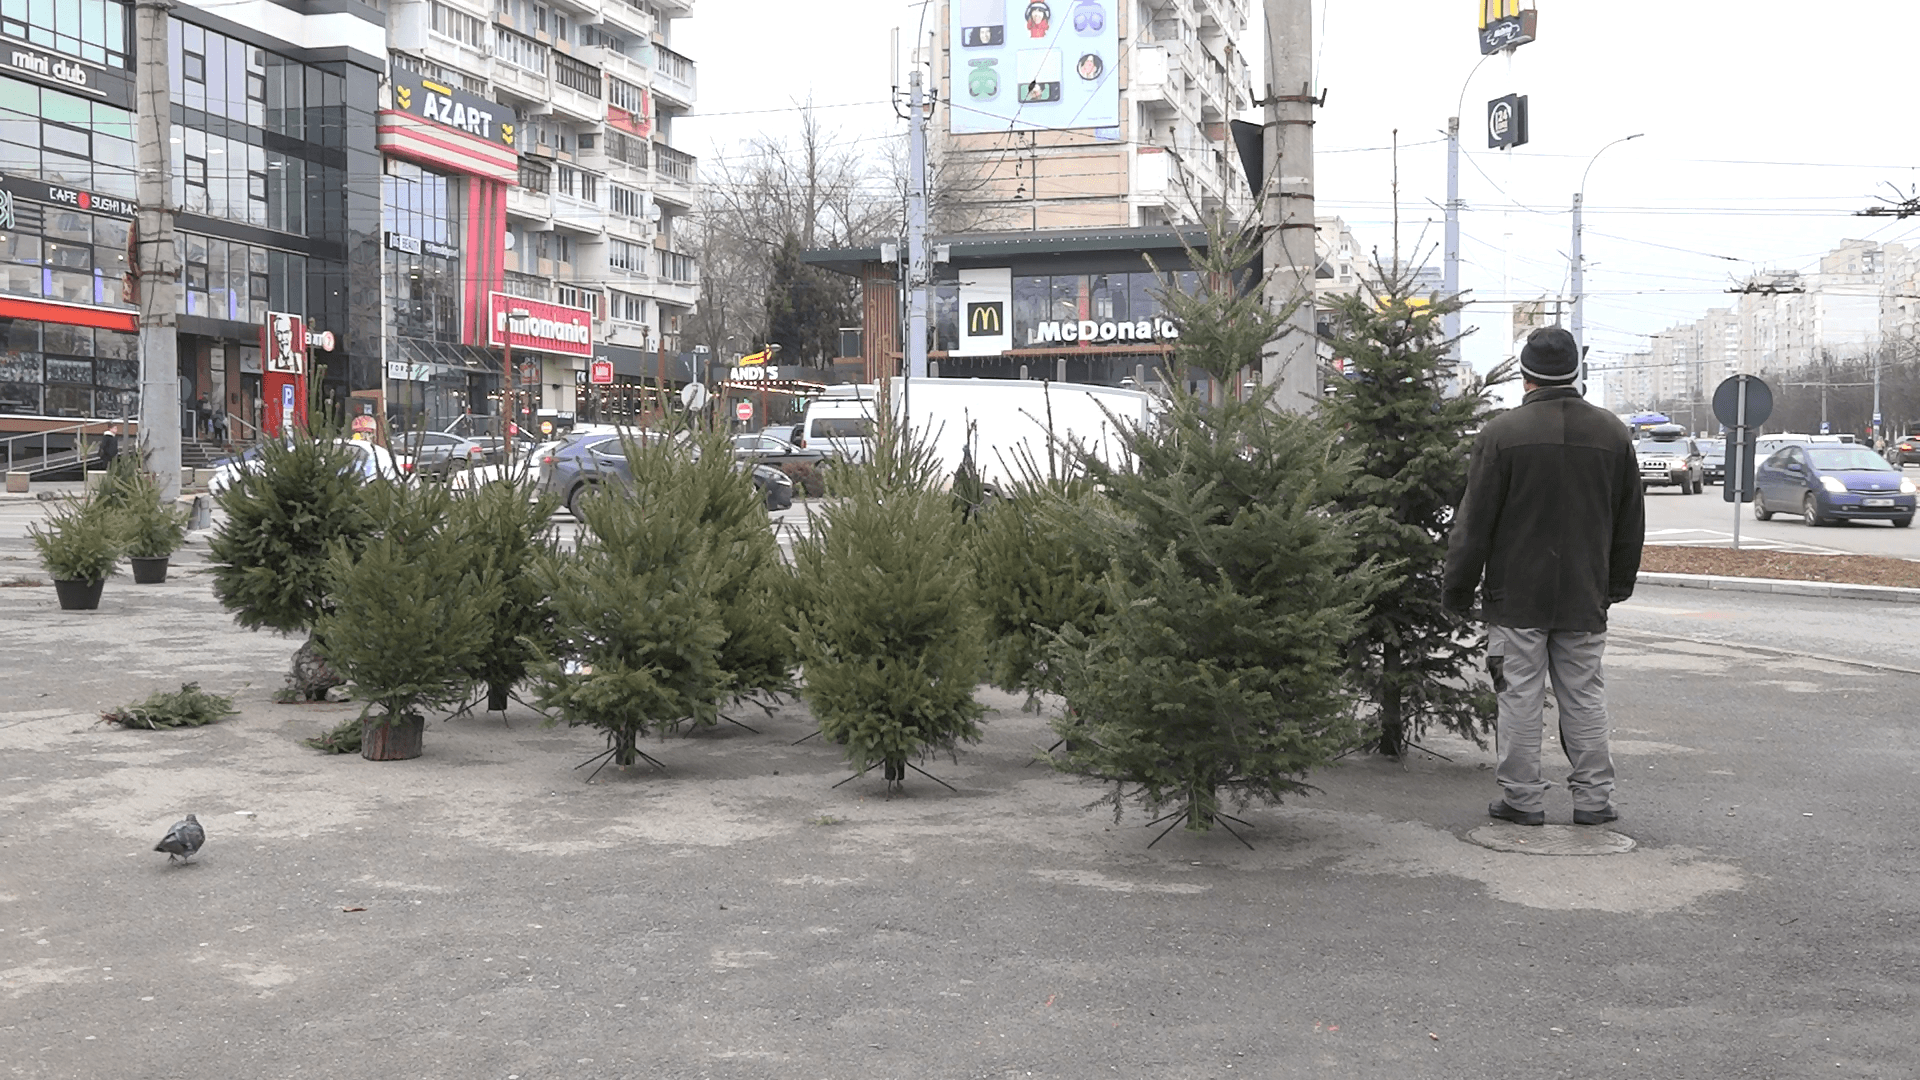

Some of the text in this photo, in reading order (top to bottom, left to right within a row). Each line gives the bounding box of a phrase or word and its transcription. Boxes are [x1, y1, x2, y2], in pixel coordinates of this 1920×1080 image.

[12, 51, 49, 75] mini
[423, 92, 492, 138] AZART
[49, 187, 77, 204] CAFE
[91, 196, 119, 213] SUSHI
[1037, 318, 1179, 342] McDonald
[284, 387, 292, 405] P
